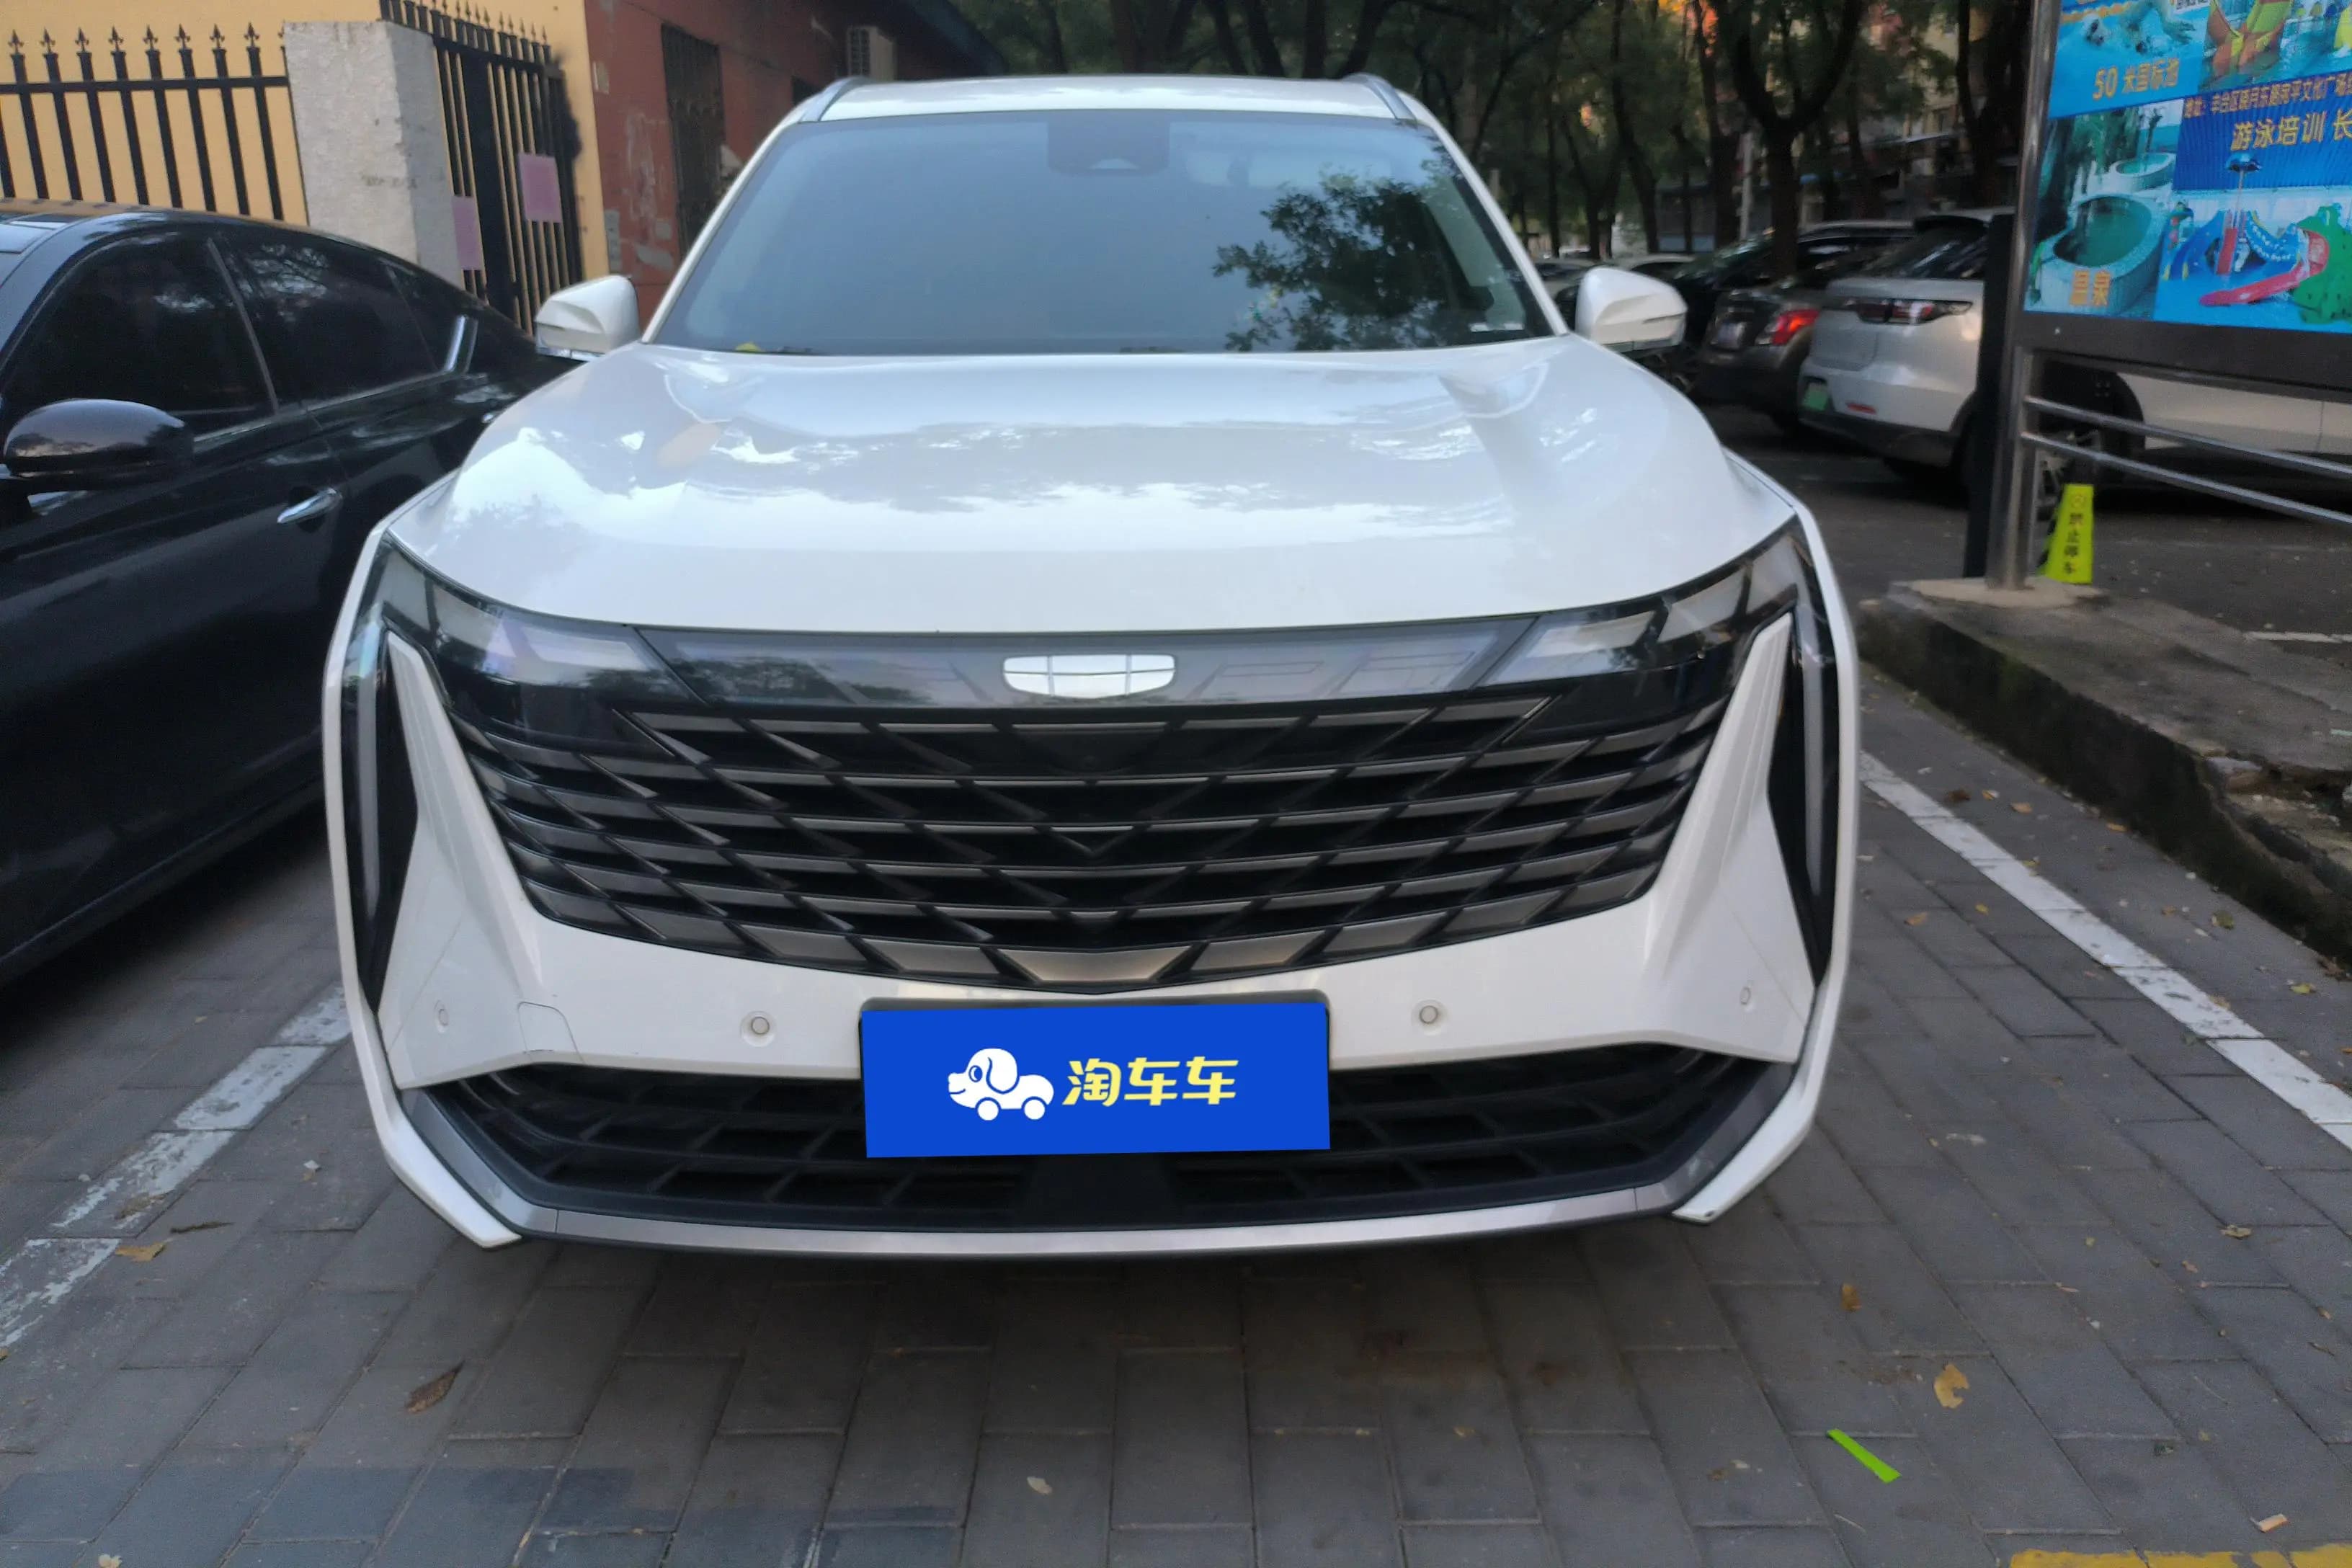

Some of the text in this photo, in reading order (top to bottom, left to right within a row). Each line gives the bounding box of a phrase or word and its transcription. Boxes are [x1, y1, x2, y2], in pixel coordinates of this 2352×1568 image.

[2093, 66, 2118, 99] 50
[2231, 110, 2327, 151] 游泳培训
